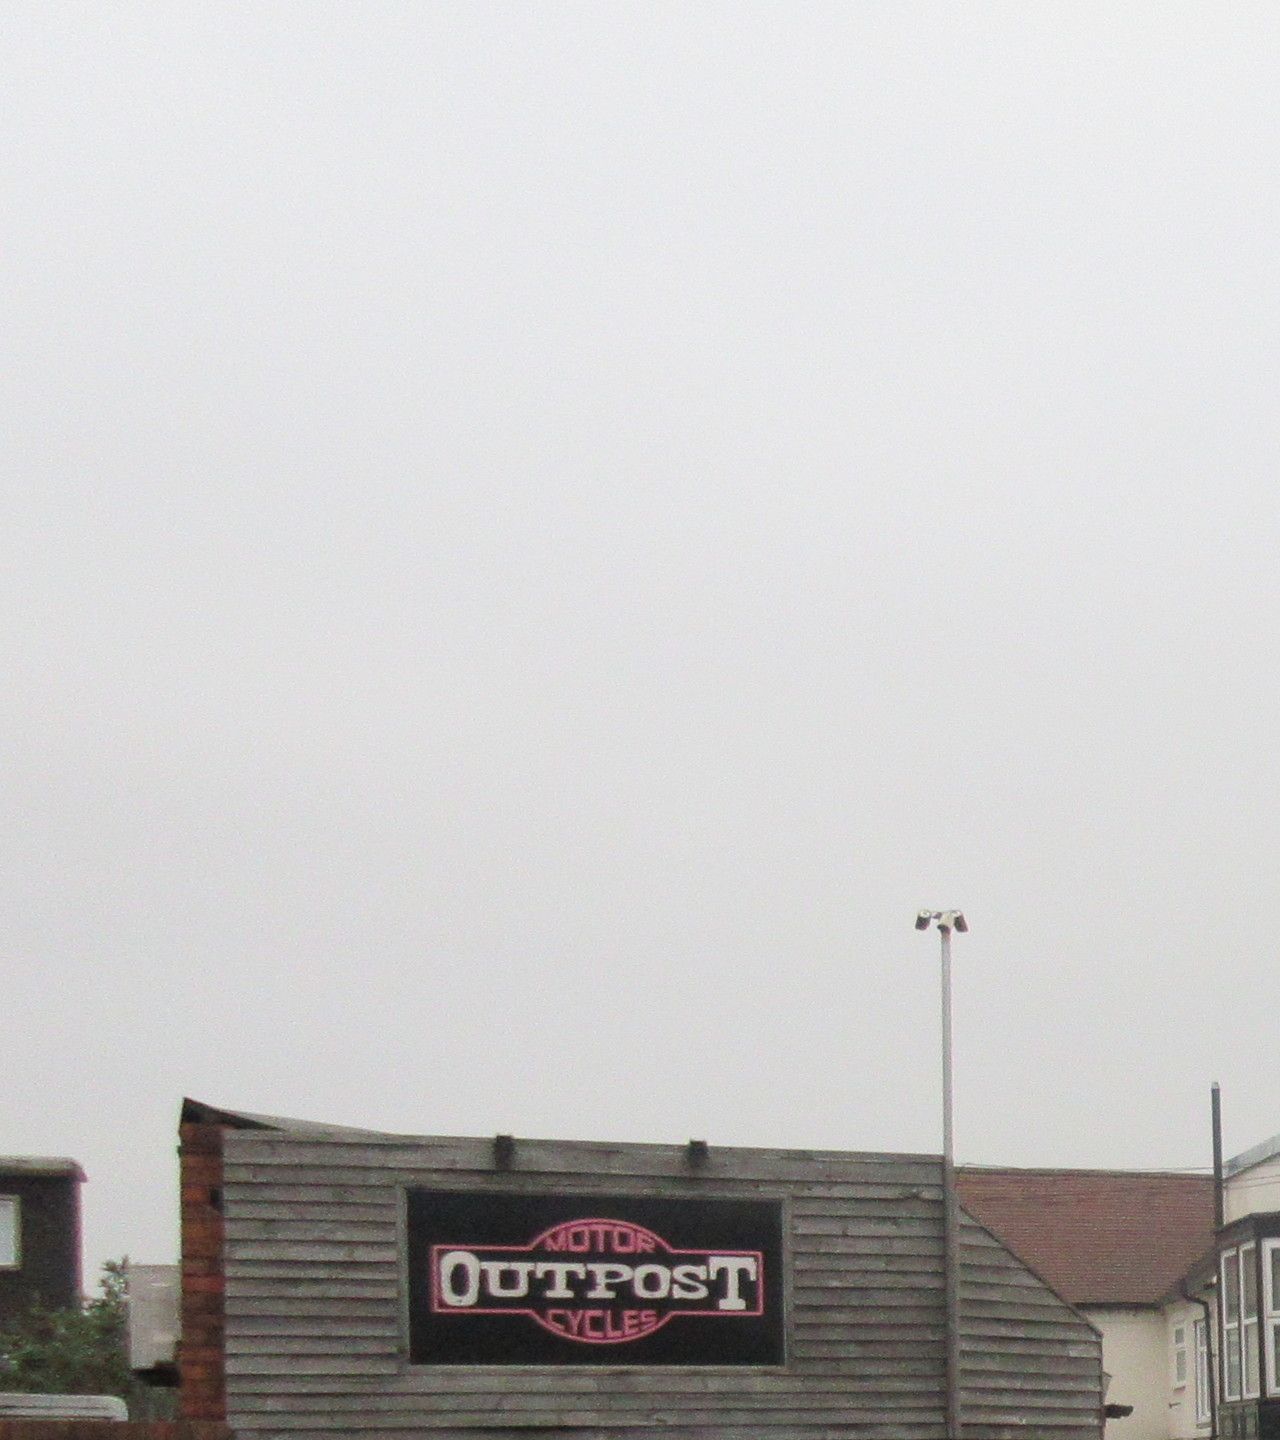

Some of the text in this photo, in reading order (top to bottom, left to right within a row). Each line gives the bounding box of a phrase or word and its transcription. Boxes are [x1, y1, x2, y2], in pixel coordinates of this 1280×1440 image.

[545, 1227, 656, 1253] MOTOR
[440, 1250, 758, 1310] OUTPOST
[546, 1309, 658, 1338] CYCLES
